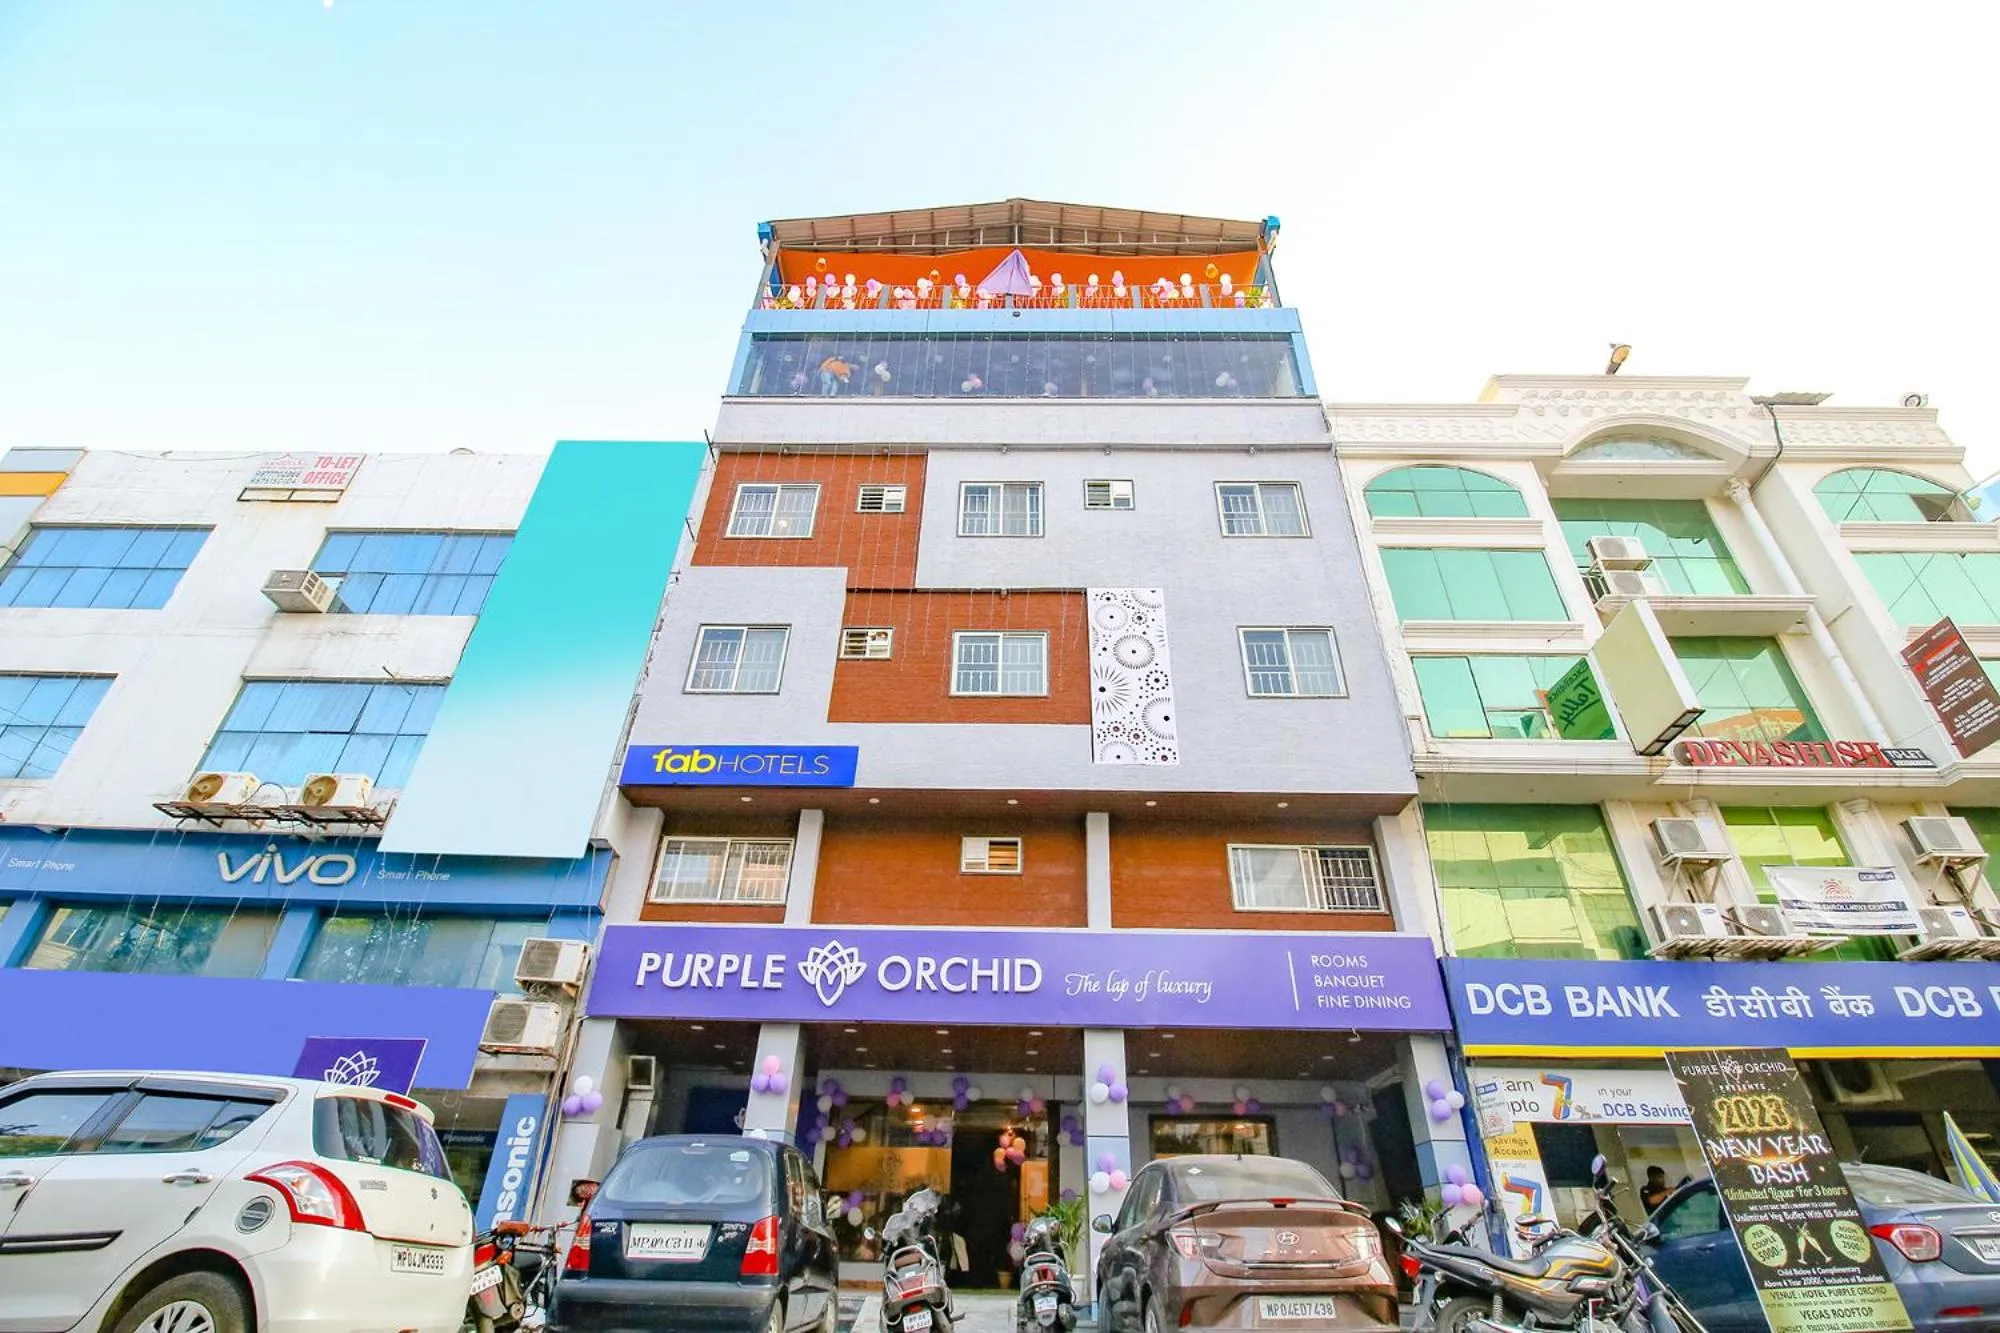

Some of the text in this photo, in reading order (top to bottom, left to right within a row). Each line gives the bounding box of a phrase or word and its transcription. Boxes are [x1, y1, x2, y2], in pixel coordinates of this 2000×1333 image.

[314, 456, 358, 469] TO-LET
[303, 471, 348, 485] OFFICE
[1684, 740, 1893, 767] DEVASHISH
[8, 857, 76, 872] Smart Phone
[377, 868, 450, 882] Smart Phone
[1311, 955, 1368, 969] ROOMS
[636, 952, 787, 989] PURPLE
[877, 955, 1043, 993] ORCHID
[1065, 970, 1213, 1003] The lap of luxury
[1314, 975, 1385, 988] BANQUET
[1318, 995, 1412, 1010] FINE DINING
[1465, 983, 1681, 1019] DCB BANK
[1702, 985, 1872, 1019] डीसीबी बैंक
[1894, 985, 1982, 1018] DCB
[1681, 1061, 1786, 1076] PURPLE ORCHID
[1503, 1078, 1534, 1093] arn
[1611, 1087, 1632, 1099] your
[1507, 1098, 1540, 1116] pto
[1603, 1103, 1636, 1117] DCB
[1715, 1095, 1792, 1132] 2023
[1494, 1148, 1532, 1156] Account
[1707, 1135, 1830, 1158] NEW YEAR
[1748, 1162, 1811, 1184] BASH
[1806, 1210, 1823, 1219] With
[1833, 1208, 1859, 1218] Snacks
[1752, 1229, 1765, 1239] PER
[1752, 1235, 1777, 1250] COUPLE
[1770, 1286, 1887, 1300] VENUE HOTEL PURPLE ORCHID
[1800, 1307, 1874, 1320] VEGAS ROOFTOP
